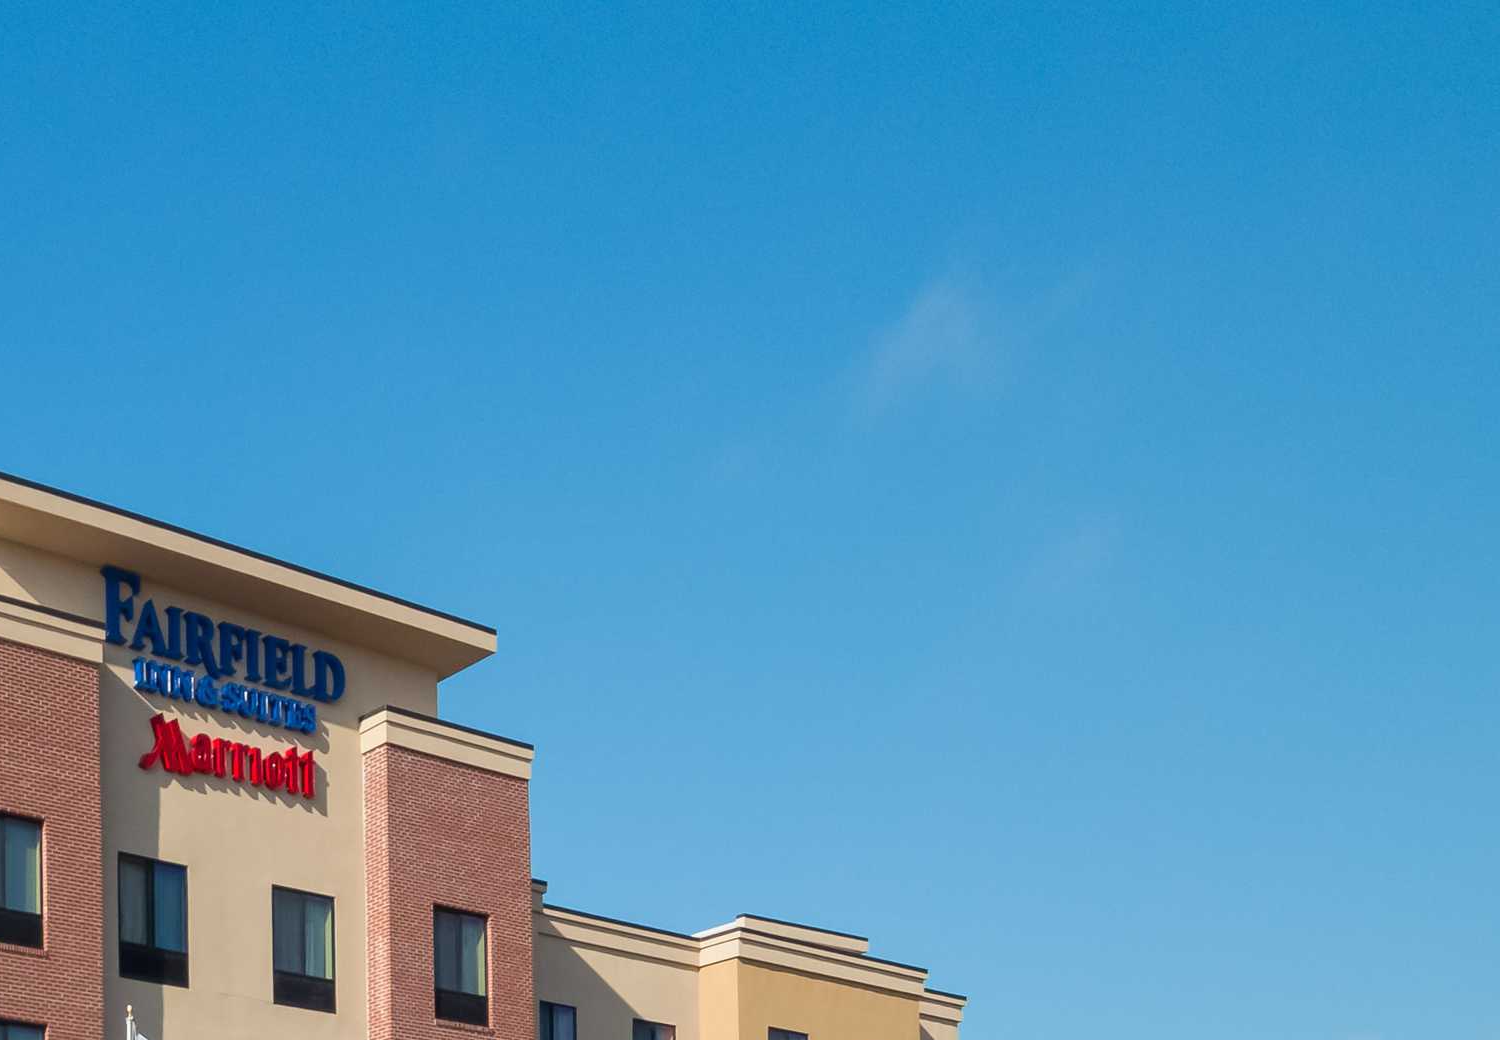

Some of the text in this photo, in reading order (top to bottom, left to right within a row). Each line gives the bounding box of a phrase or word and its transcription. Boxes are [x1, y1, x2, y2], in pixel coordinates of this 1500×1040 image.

[101, 564, 346, 704] FAIRFIELD
[132, 656, 194, 702] INN
[220, 682, 317, 735] SUITES
[138, 712, 315, 799] Marriott
